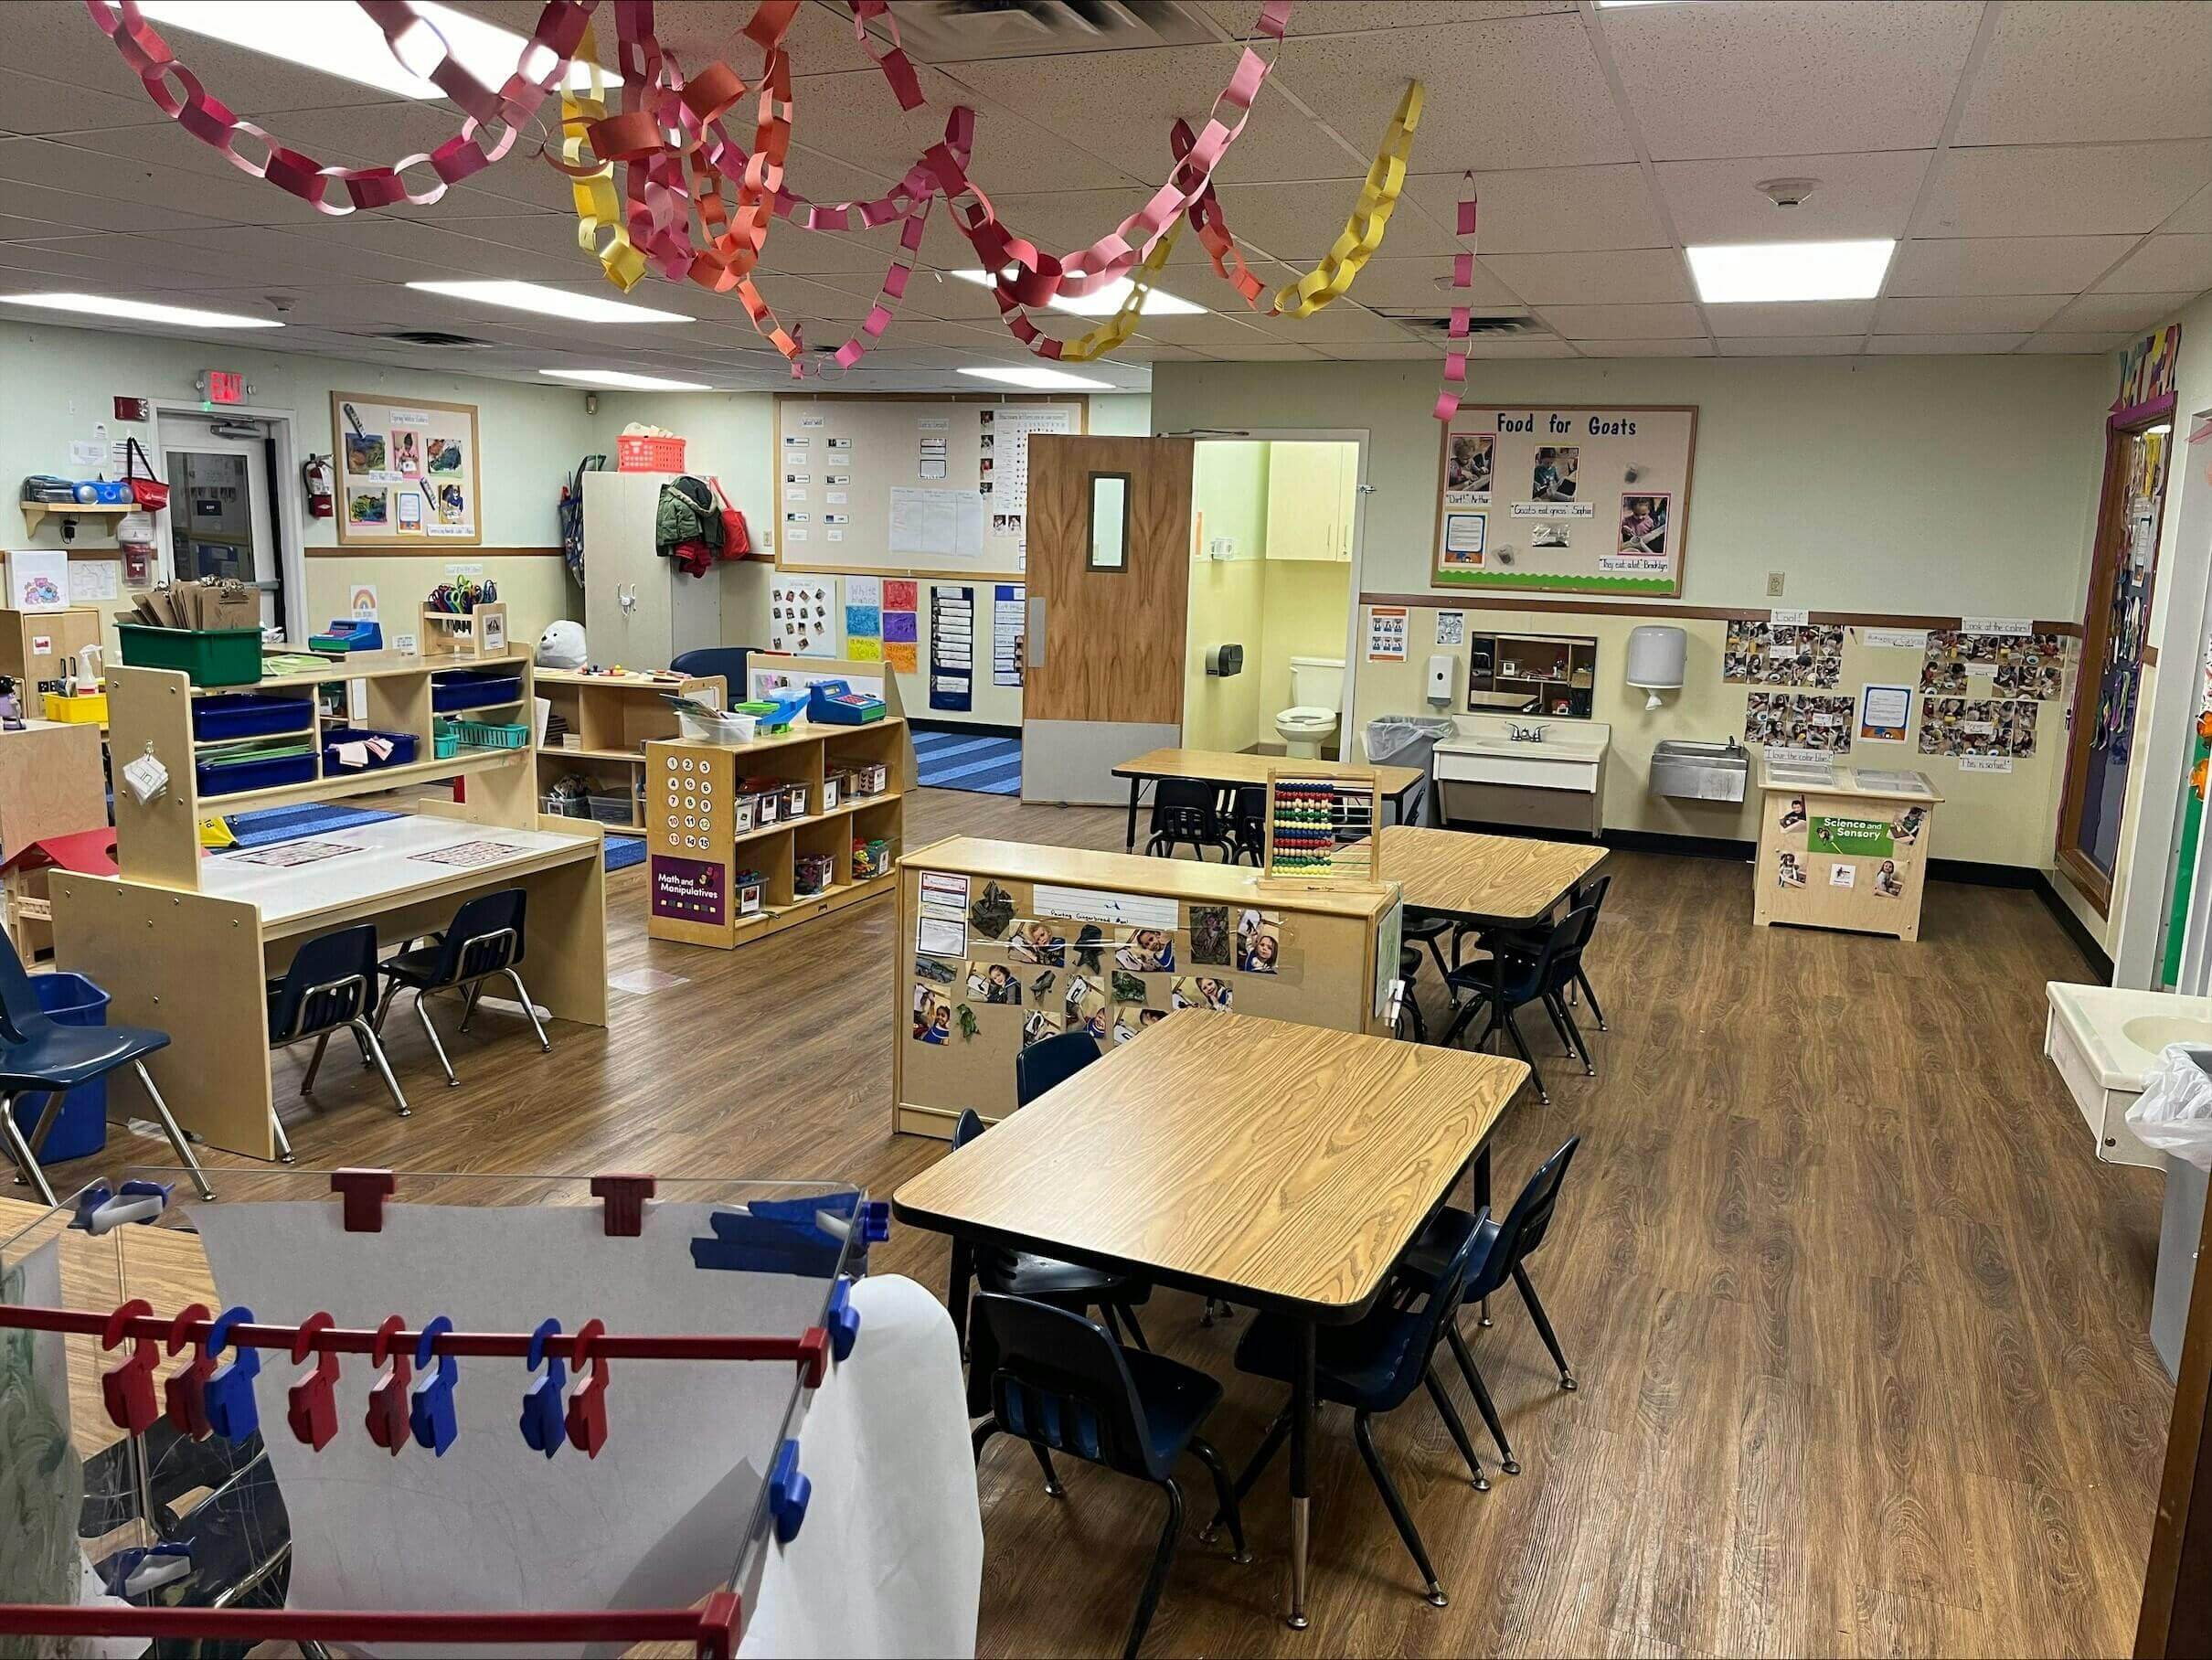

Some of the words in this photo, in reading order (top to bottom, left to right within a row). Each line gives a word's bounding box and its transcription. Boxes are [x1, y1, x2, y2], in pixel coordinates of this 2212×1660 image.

[211, 372, 242, 402] EXIT
[1497, 412, 1534, 432] Food
[1549, 413, 1571, 433] for
[1589, 416, 1636, 435] Goats
[687, 798, 693, 806] 8
[703, 802, 708, 810] 9
[670, 817, 677, 825] 10
[686, 816, 694, 825] 11
[1824, 817, 1866, 829] Science
[671, 835, 678, 843] 13
[1837, 827, 1881, 841] Sensory
[686, 836, 695, 846] 14
[700, 838, 708, 847] 15
[658, 872, 680, 885] Math
[681, 878, 694, 887] and
[660, 882, 718, 899] Manipulatives
